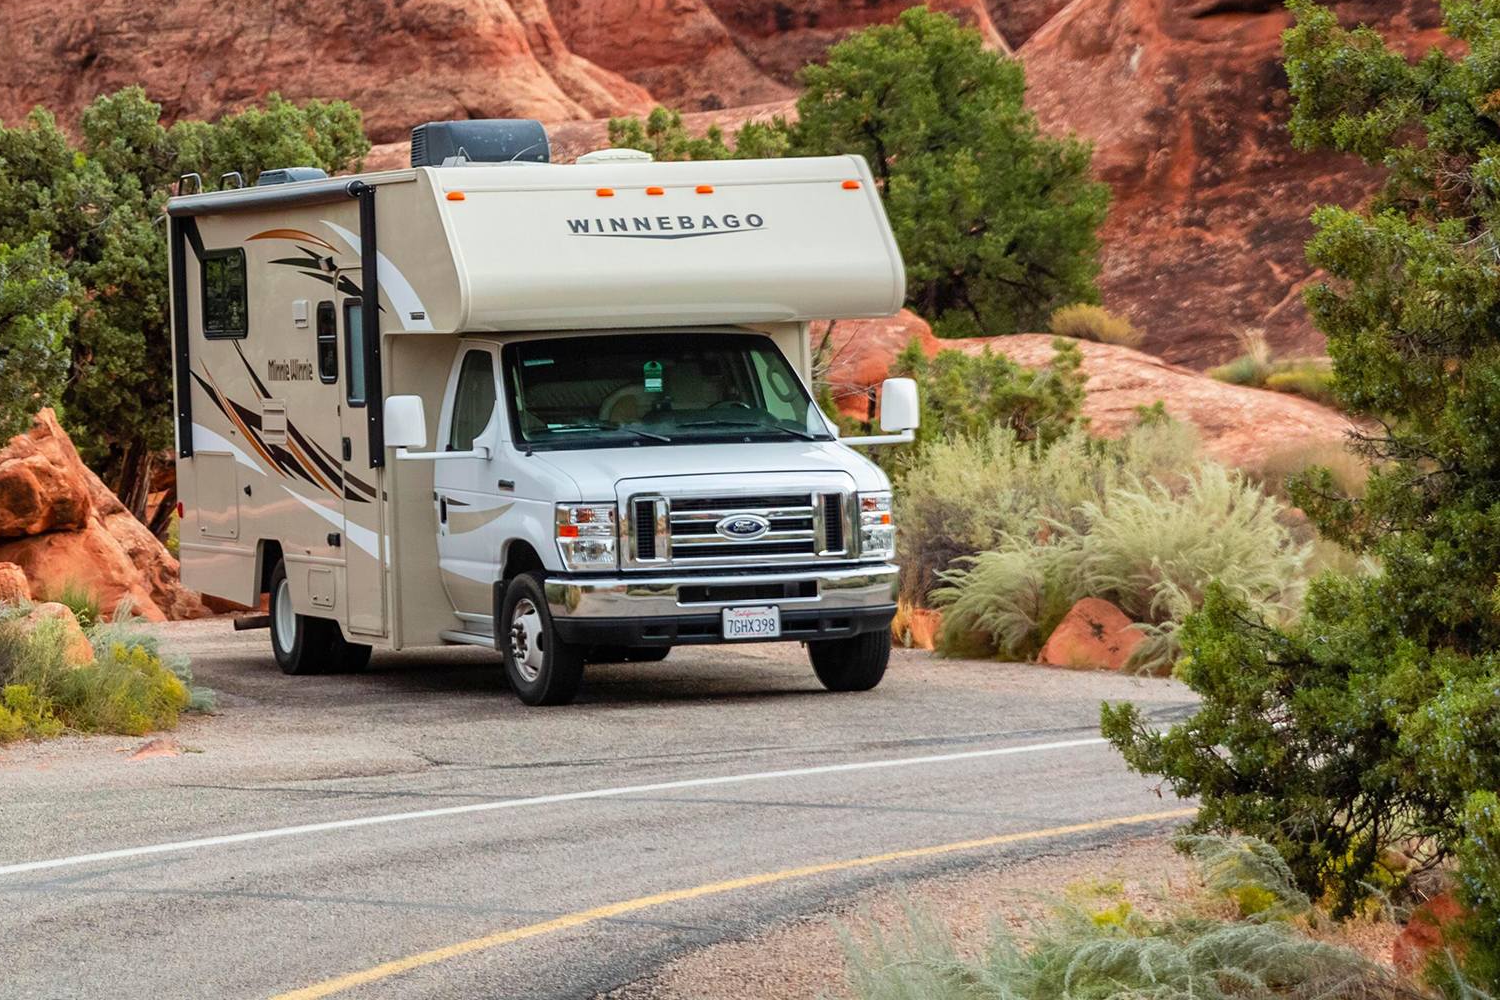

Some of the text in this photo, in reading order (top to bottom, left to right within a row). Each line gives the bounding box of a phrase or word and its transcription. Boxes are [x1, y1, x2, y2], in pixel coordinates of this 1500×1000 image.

[566, 213, 764, 233] WINNEBAGO
[268, 358, 313, 381] Minnie Winnie
[733, 519, 756, 532] Ford
[728, 618, 775, 633] 7GHX398
